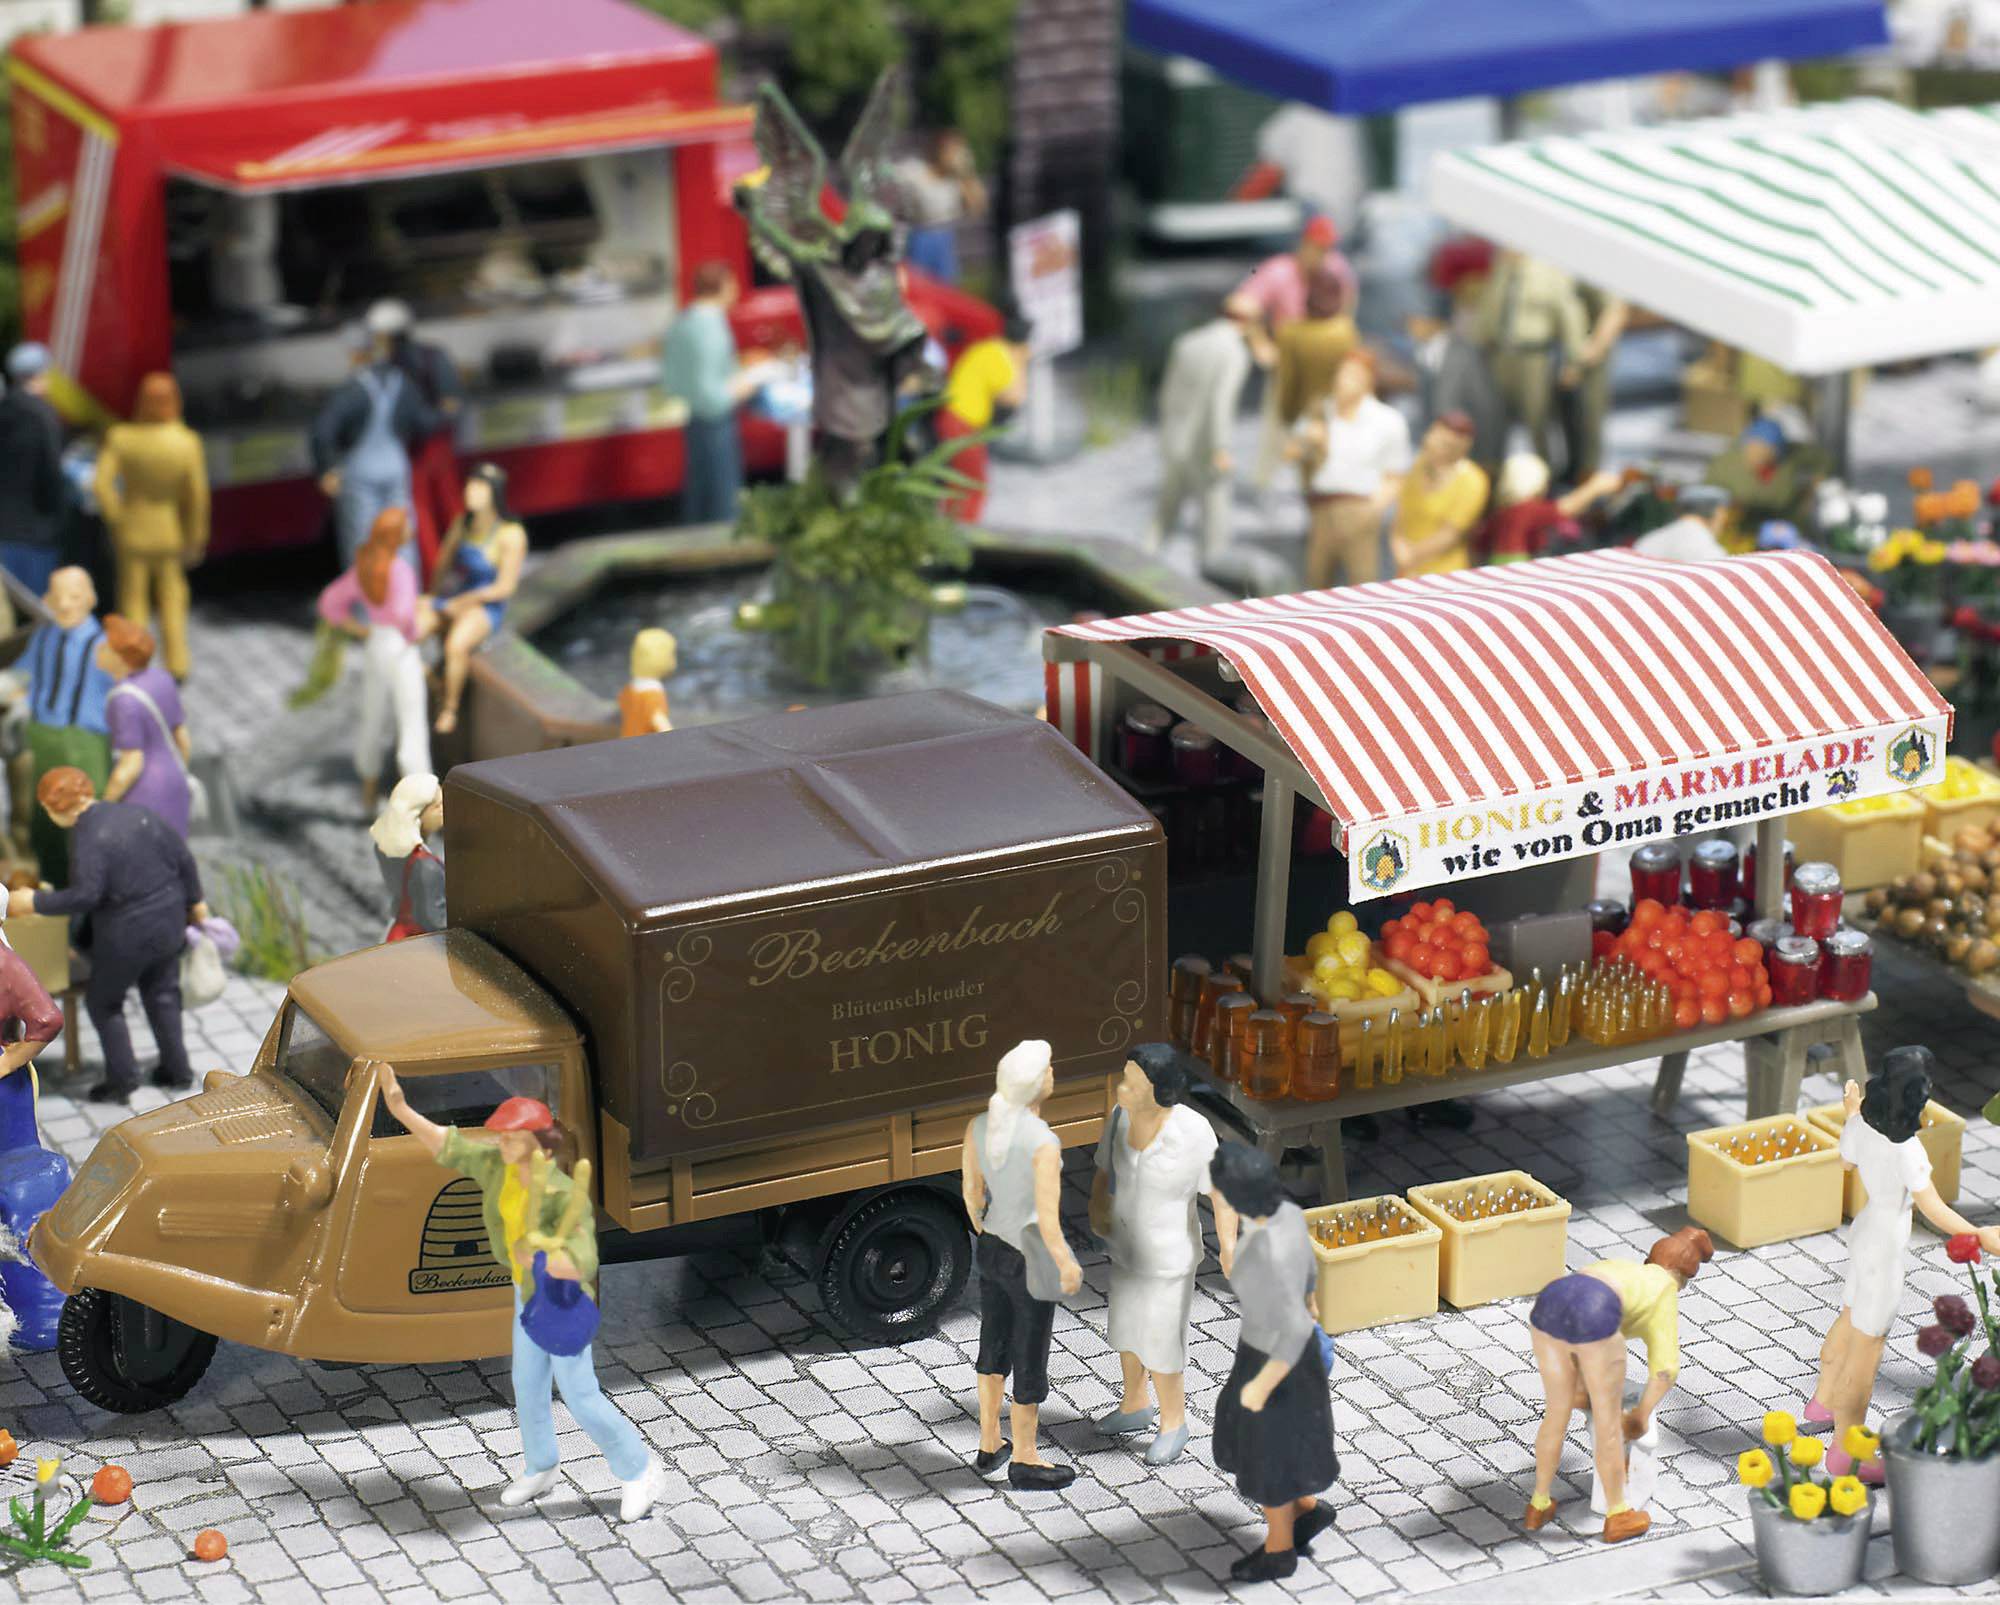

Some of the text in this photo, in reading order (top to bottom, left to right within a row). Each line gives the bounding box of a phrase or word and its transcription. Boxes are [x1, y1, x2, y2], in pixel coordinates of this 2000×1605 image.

[1418, 736, 1875, 850] HONIG & MARMELADE
[1441, 783, 1810, 875] wie von Oma gemacht
[747, 892, 1063, 986] Beckenbach
[832, 979, 985, 1020] Blütenschleuder
[829, 1013, 989, 1072] HONIG
[415, 1271, 512, 1289] Beckenbac
